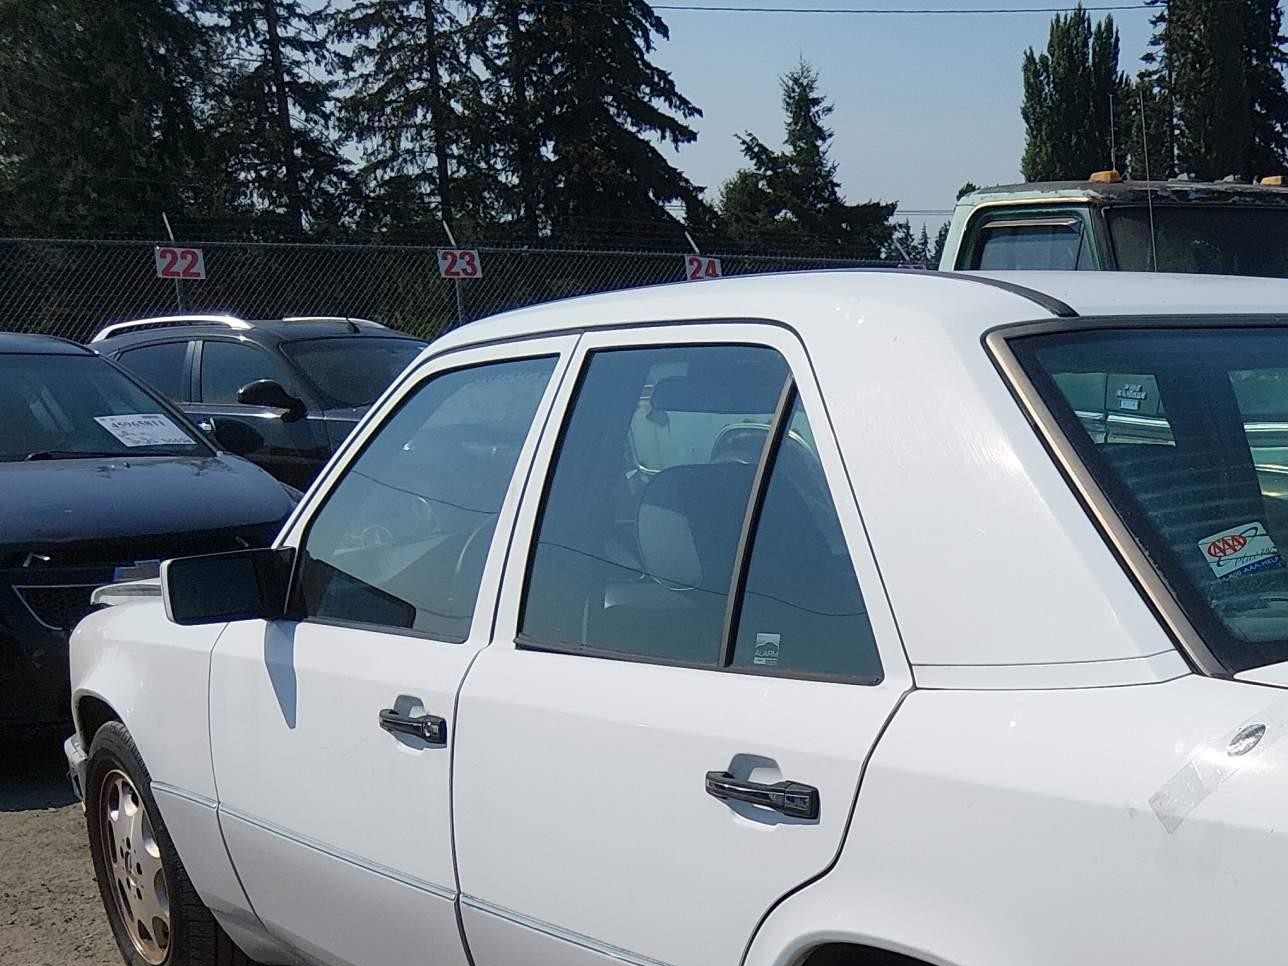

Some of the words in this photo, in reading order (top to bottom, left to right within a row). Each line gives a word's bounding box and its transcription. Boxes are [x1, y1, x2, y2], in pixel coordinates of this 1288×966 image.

[159, 249, 201, 278] 22
[441, 251, 478, 277] 23
[688, 257, 720, 280] 24
[1211, 535, 1246, 557] AAA
